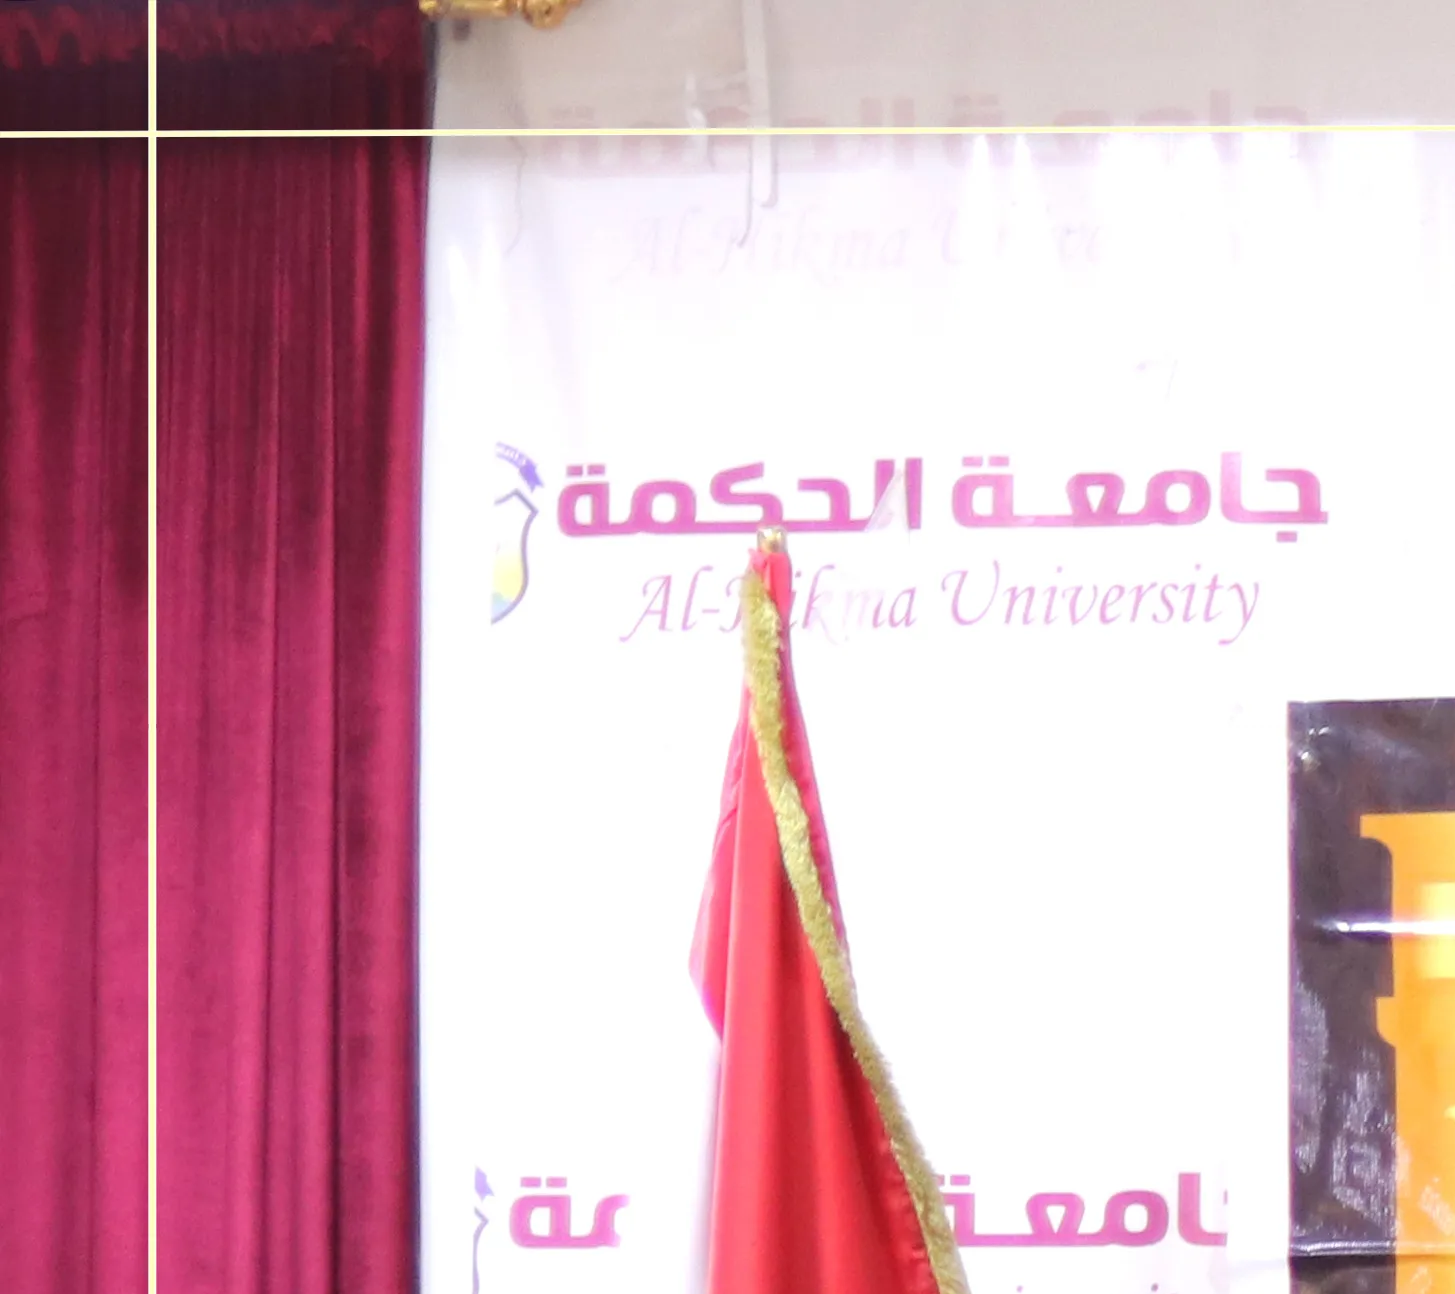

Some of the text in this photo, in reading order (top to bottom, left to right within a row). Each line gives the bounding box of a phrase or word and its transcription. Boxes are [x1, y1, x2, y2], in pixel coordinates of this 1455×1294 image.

[556, 450, 1330, 543] جامعة الحكمة
[939, 559, 1260, 647] University
[935, 1172, 1229, 1248] امعة
